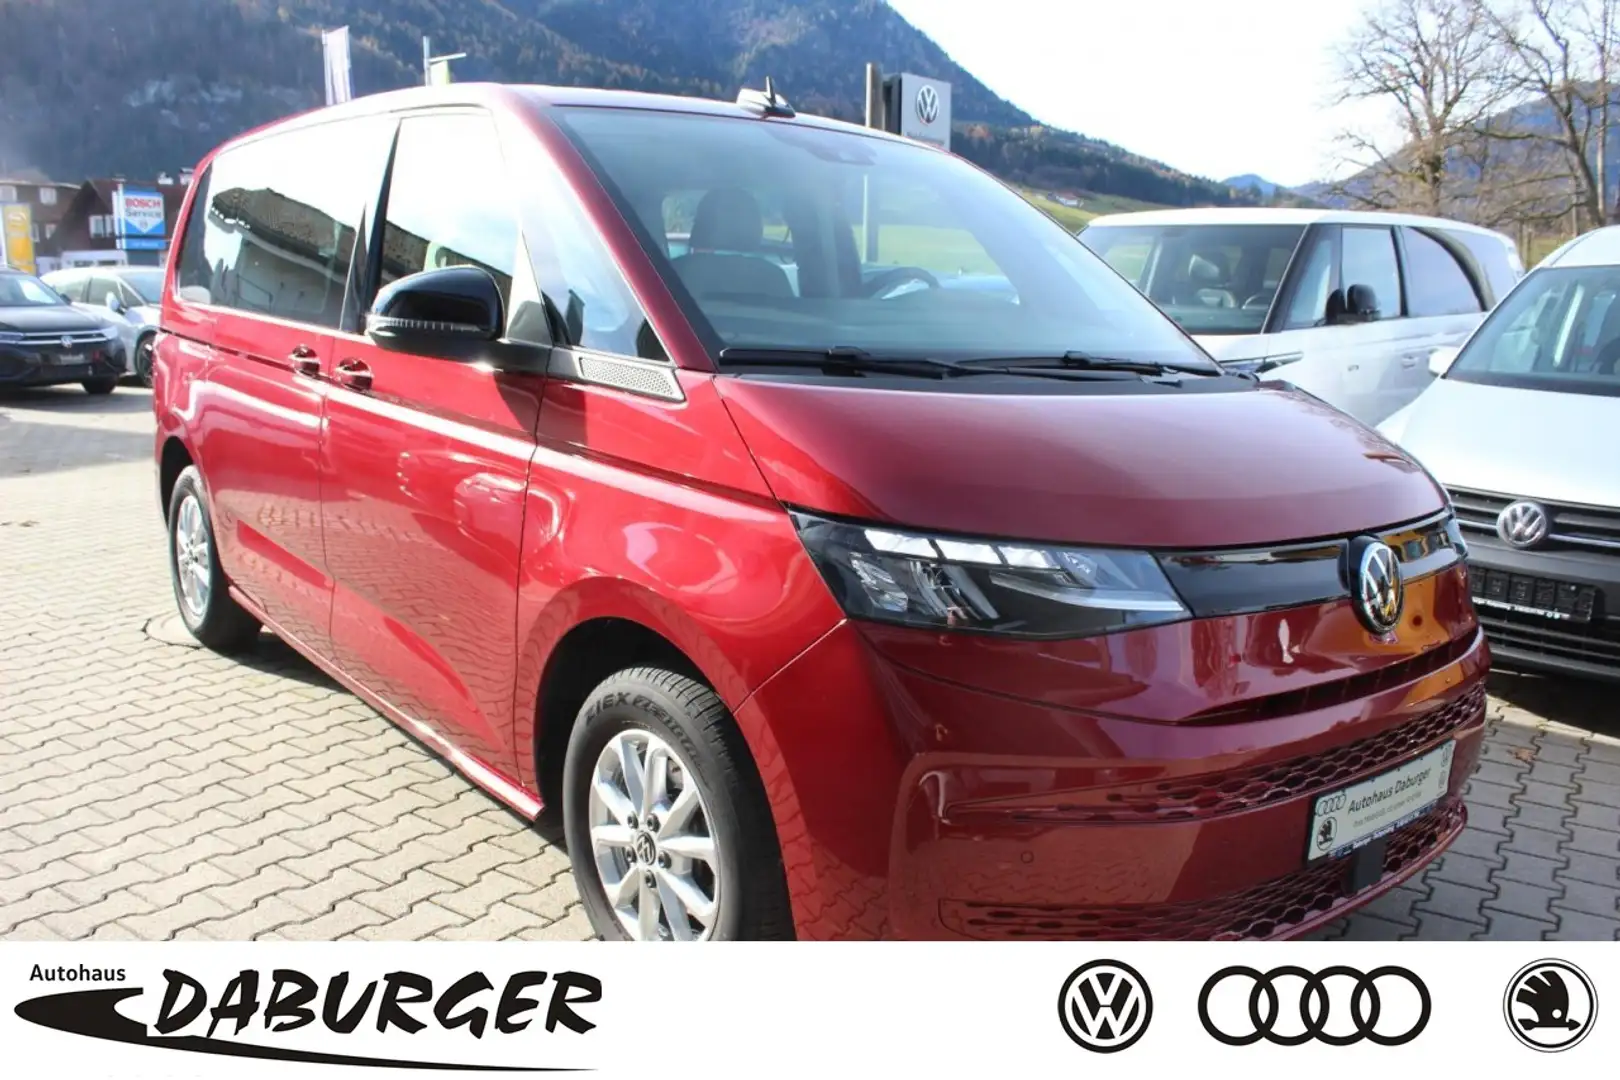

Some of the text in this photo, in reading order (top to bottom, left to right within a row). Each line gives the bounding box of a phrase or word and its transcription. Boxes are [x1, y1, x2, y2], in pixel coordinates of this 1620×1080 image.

[125, 197, 161, 208] BOSCH
[1348, 787, 1394, 815] Autohaus
[1395, 767, 1432, 795] Daburger
